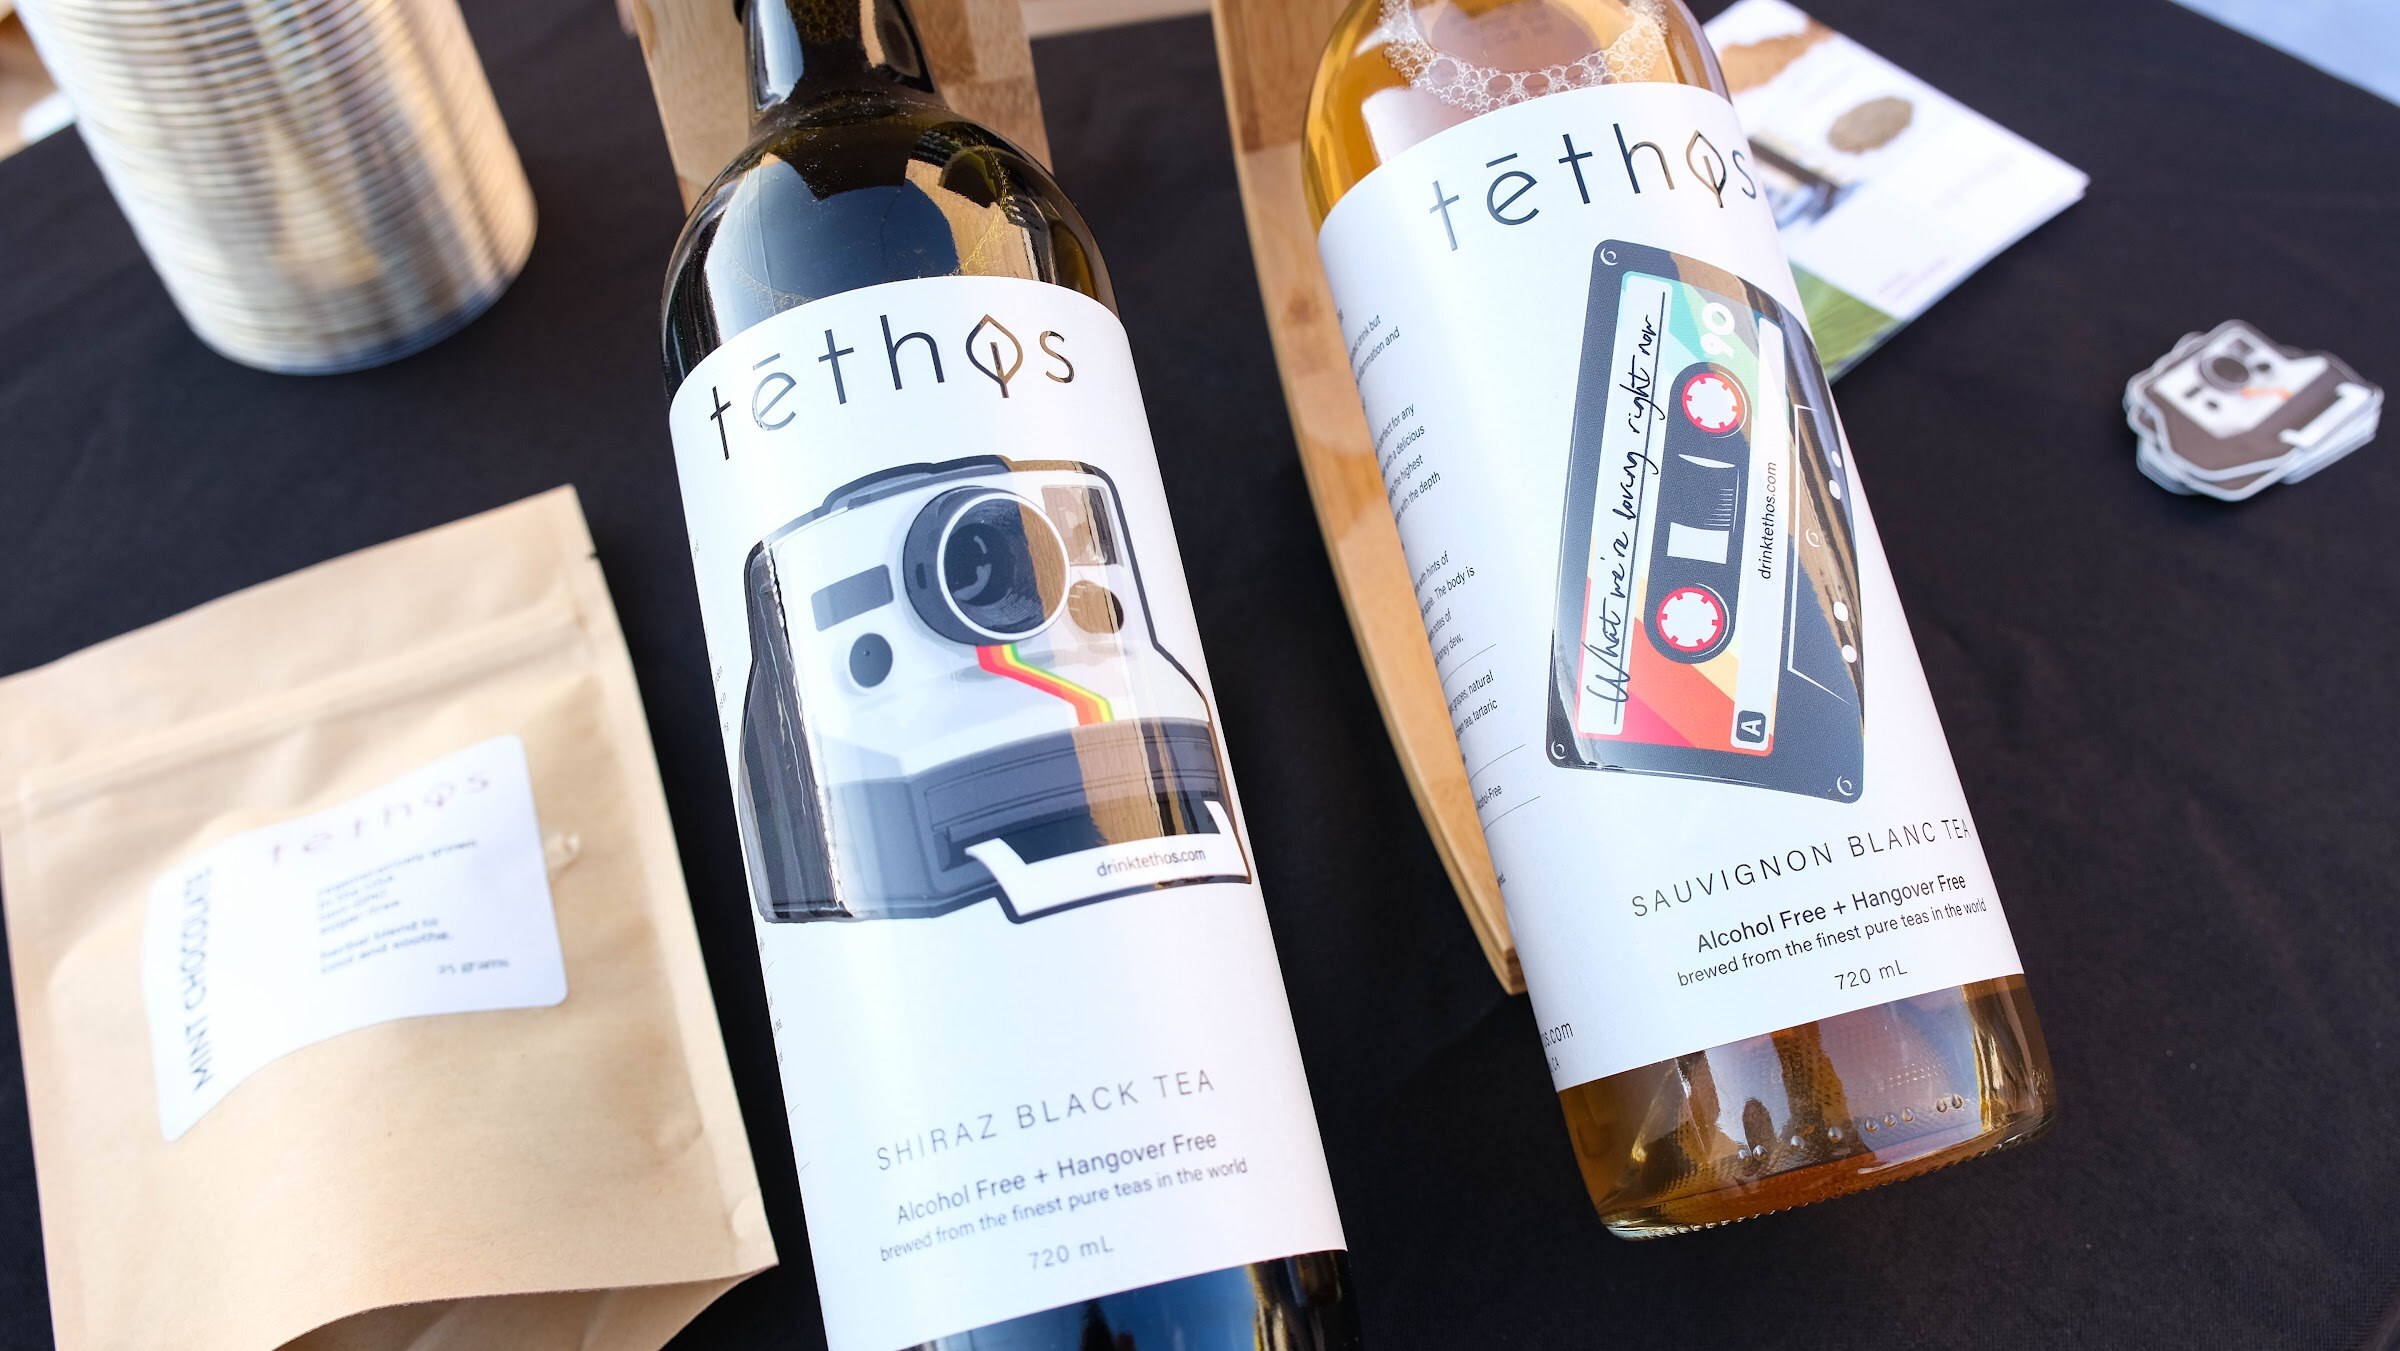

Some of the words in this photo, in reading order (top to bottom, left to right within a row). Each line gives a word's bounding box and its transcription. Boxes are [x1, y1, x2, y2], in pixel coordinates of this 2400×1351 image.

[1368, 314, 1381, 331] but
[1385, 325, 1400, 346] and
[1638, 314, 1657, 355] now
[1701, 302, 1735, 360] 90
[1619, 355, 1666, 433] right
[1391, 415, 1401, 429] for
[1401, 403, 1415, 420] any
[1396, 425, 1425, 454] delicious
[1400, 454, 1424, 479] highest
[1408, 488, 1419, 502] the
[1419, 471, 1441, 494] depth
[1613, 451, 1659, 520] loving
[1757, 460, 1778, 580] drinktethos.com
[1426, 560, 1441, 578] hints
[1441, 550, 1449, 566] of
[1600, 531, 1629, 598] we're
[1434, 585, 1446, 600] The
[1446, 572, 1465, 590] body
[1466, 566, 1475, 578] is
[1445, 608, 1452, 623] of
[1581, 597, 1631, 703] What
[1468, 669, 1494, 693] natural
[1472, 699, 1498, 721] tartaric
[1740, 719, 1762, 737] A
[1097, 849, 1206, 877] drinktethos.com
[1631, 842, 1834, 918] SAUVIGNON
[1847, 822, 1935, 857] BLANC
[1941, 819, 1971, 839] TEA
[1698, 914, 1775, 953] Alcohol
[1779, 906, 1827, 929] Free
[1833, 901, 1846, 915] +
[1852, 880, 1934, 910] Hangover
[1937, 875, 1966, 892] Free
[180, 865, 213, 1010] CHOCOLATE
[1677, 956, 1739, 986] brewed
[1742, 949, 1782, 968] from
[1785, 940, 1813, 957] the
[1816, 926, 1861, 948] finest
[1865, 918, 1898, 939] pure
[1901, 911, 1930, 927] teas
[1931, 907, 1943, 921] in
[1944, 903, 1963, 918] the
[1963, 897, 1987, 913] world
[1834, 968, 1871, 990] 720
[1879, 960, 1908, 979] mL
[185, 1016, 213, 1094] MINT
[877, 1113, 997, 1170] SHIRAZ
[1016, 1080, 1138, 1129] BLACK
[1153, 1069, 1214, 1098] TEA
[898, 1185, 970, 1224] Alcohol
[976, 1175, 1025, 1199] Free
[1034, 1169, 1048, 1183] +
[1057, 1141, 1166, 1178] Hangover
[1173, 1133, 1217, 1154] Free
[880, 1231, 932, 1262] brewed
[936, 1222, 975, 1243] from
[979, 1213, 1008, 1231] the
[1012, 1197, 1063, 1221] finest
[1068, 1187, 1109, 1211] pure
[1114, 1178, 1153, 1197] teas
[1157, 1172, 1173, 1188] in
[1176, 1167, 1203, 1184] the
[1207, 1156, 1248, 1179] world
[1028, 1244, 1070, 1269] 720
[1080, 1235, 1115, 1257] mL
